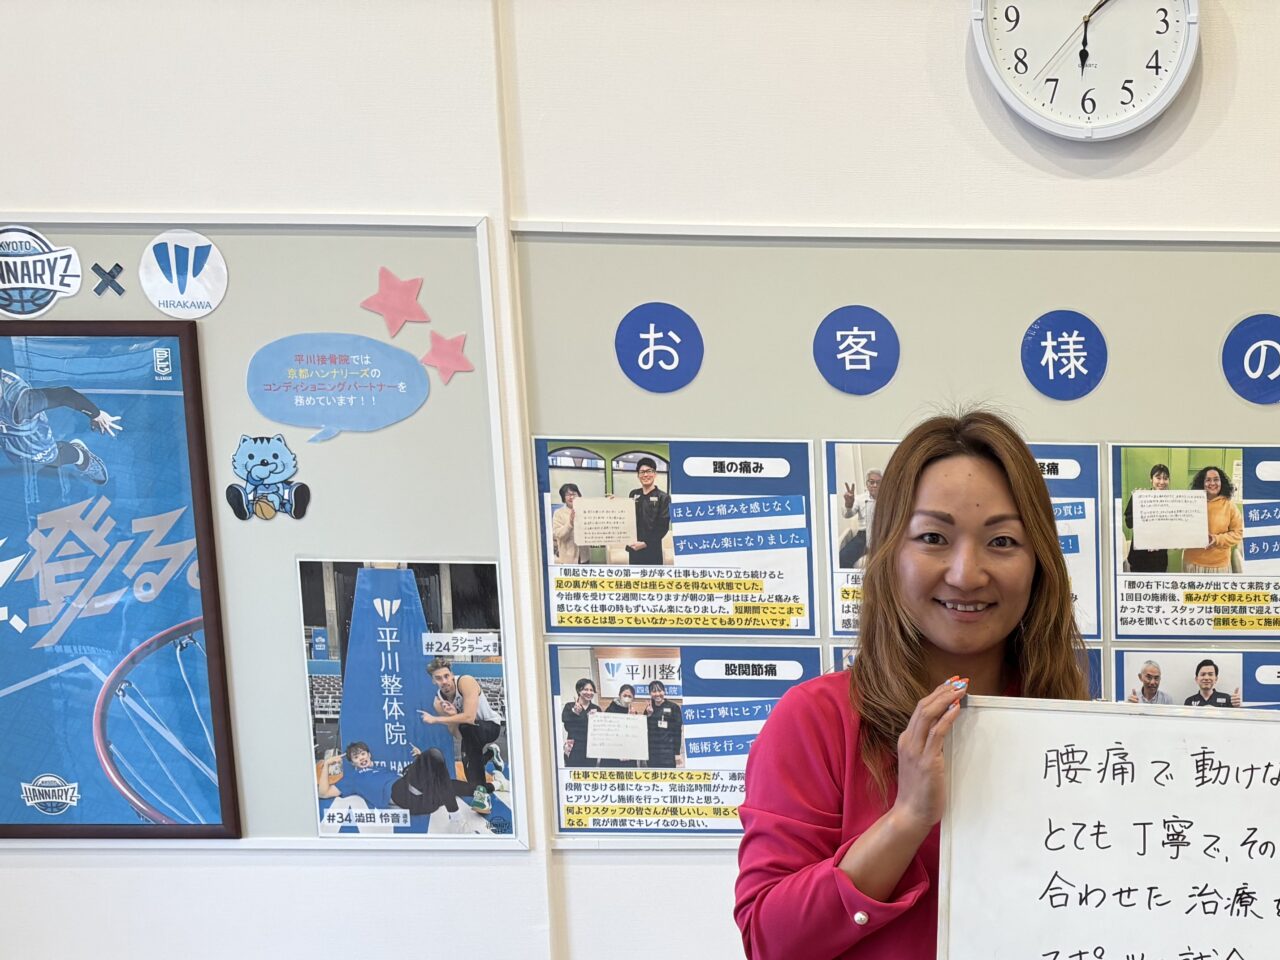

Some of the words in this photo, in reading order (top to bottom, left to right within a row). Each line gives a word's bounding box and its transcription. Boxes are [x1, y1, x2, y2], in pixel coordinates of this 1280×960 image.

[1004, 5, 1020, 32] 9
[1155, 7, 1170, 34] 3
[1013, 48, 1028, 75] 8
[1145, 49, 1162, 75] 4
[1044, 78, 1060, 104] 7
[1120, 79, 1134, 105] 5
[1081, 87, 1096, 114] 6
[158, 299, 213, 310] HIRAKAWA
[294, 354, 372, 366] 平川接骨院では
[287, 367, 381, 380] 京都ハンナリーズの
[263, 381, 407, 393] コンディショニングパートナーを
[713, 460, 765, 474] 踵の痛み
[673, 500, 792, 518] ほとんど痛みを感じなく
[675, 533, 805, 552] ずいぶん楽になりました。
[425, 641, 451, 653] #24
[451, 636, 482, 645] ラシード
[452, 644, 491, 653] ファラーズ
[724, 663, 778, 677] 股関節痛
[376, 627, 407, 745] 平川整体院
[22, 786, 80, 803] HANNARYZ
[327, 812, 353, 824] #34
